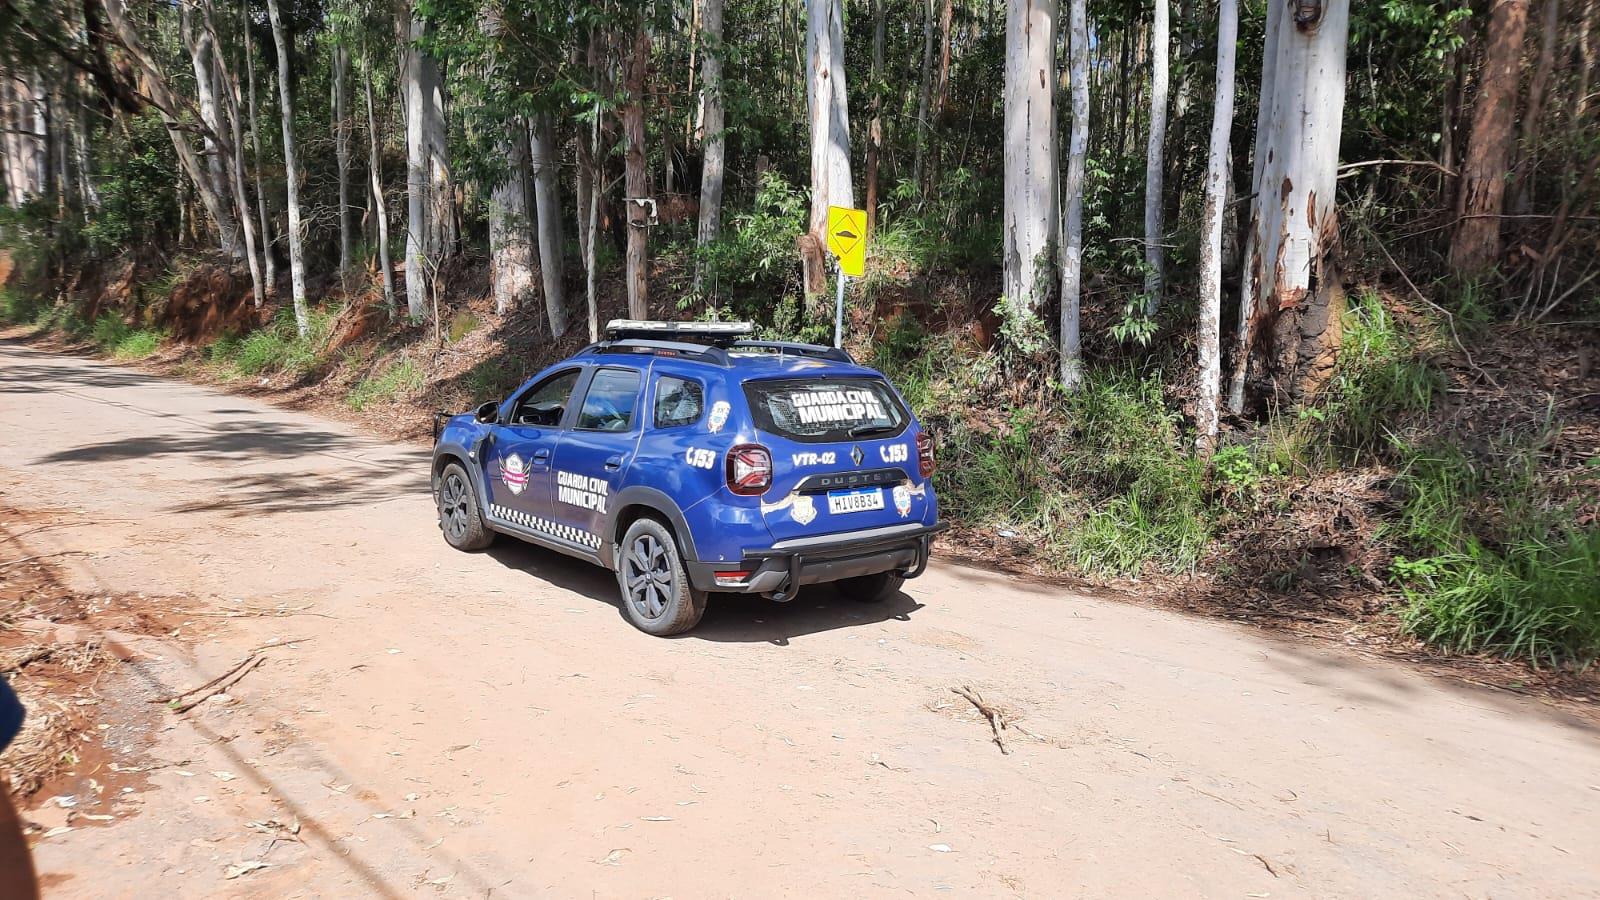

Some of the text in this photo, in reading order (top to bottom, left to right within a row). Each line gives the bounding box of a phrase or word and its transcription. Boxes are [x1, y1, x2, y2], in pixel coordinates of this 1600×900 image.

[791, 390, 879, 407] GUARDA CIVIL
[798, 403, 887, 423] MUNICIPAL
[692, 448, 716, 470] 153
[792, 451, 836, 466] VTR-02
[889, 444, 908, 463] 153
[557, 470, 608, 496] GUARDA CIVIL
[821, 473, 892, 485] DUSTER
[558, 485, 607, 514] MUNICIPAL
[834, 494, 878, 511] HIV8B34
